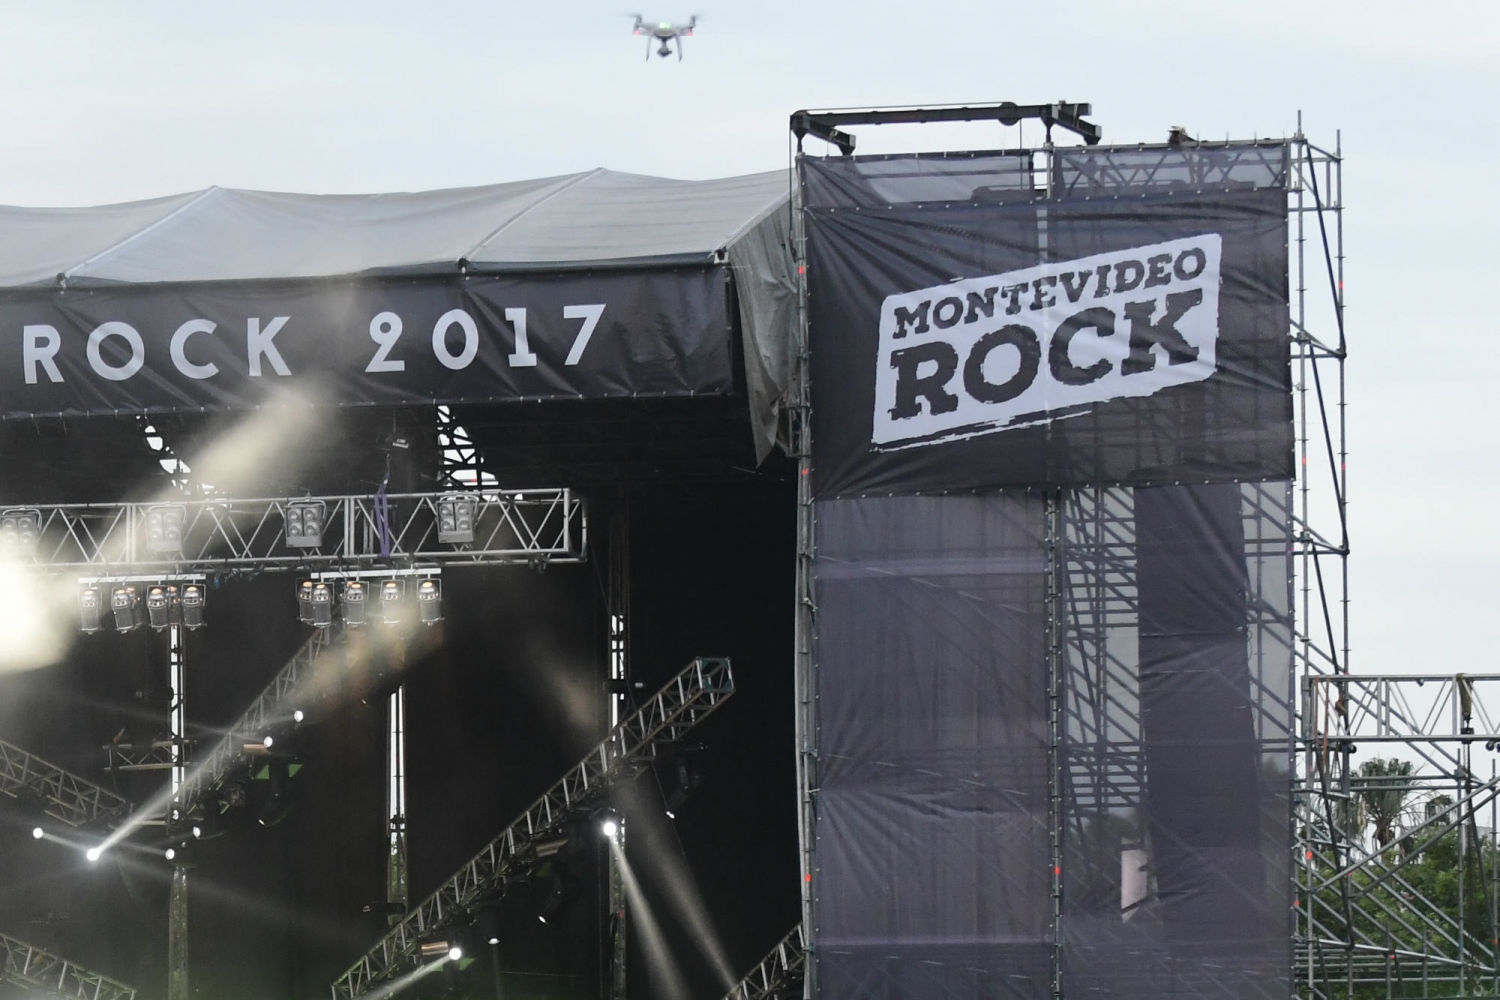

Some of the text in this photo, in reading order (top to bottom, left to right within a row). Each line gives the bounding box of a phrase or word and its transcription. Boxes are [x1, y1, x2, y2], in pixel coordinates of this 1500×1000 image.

[892, 246, 1207, 340] MONTEVIDEO
[21, 315, 293, 385] ROCK
[365, 303, 607, 373] 2017
[888, 288, 1204, 421] ROCK
